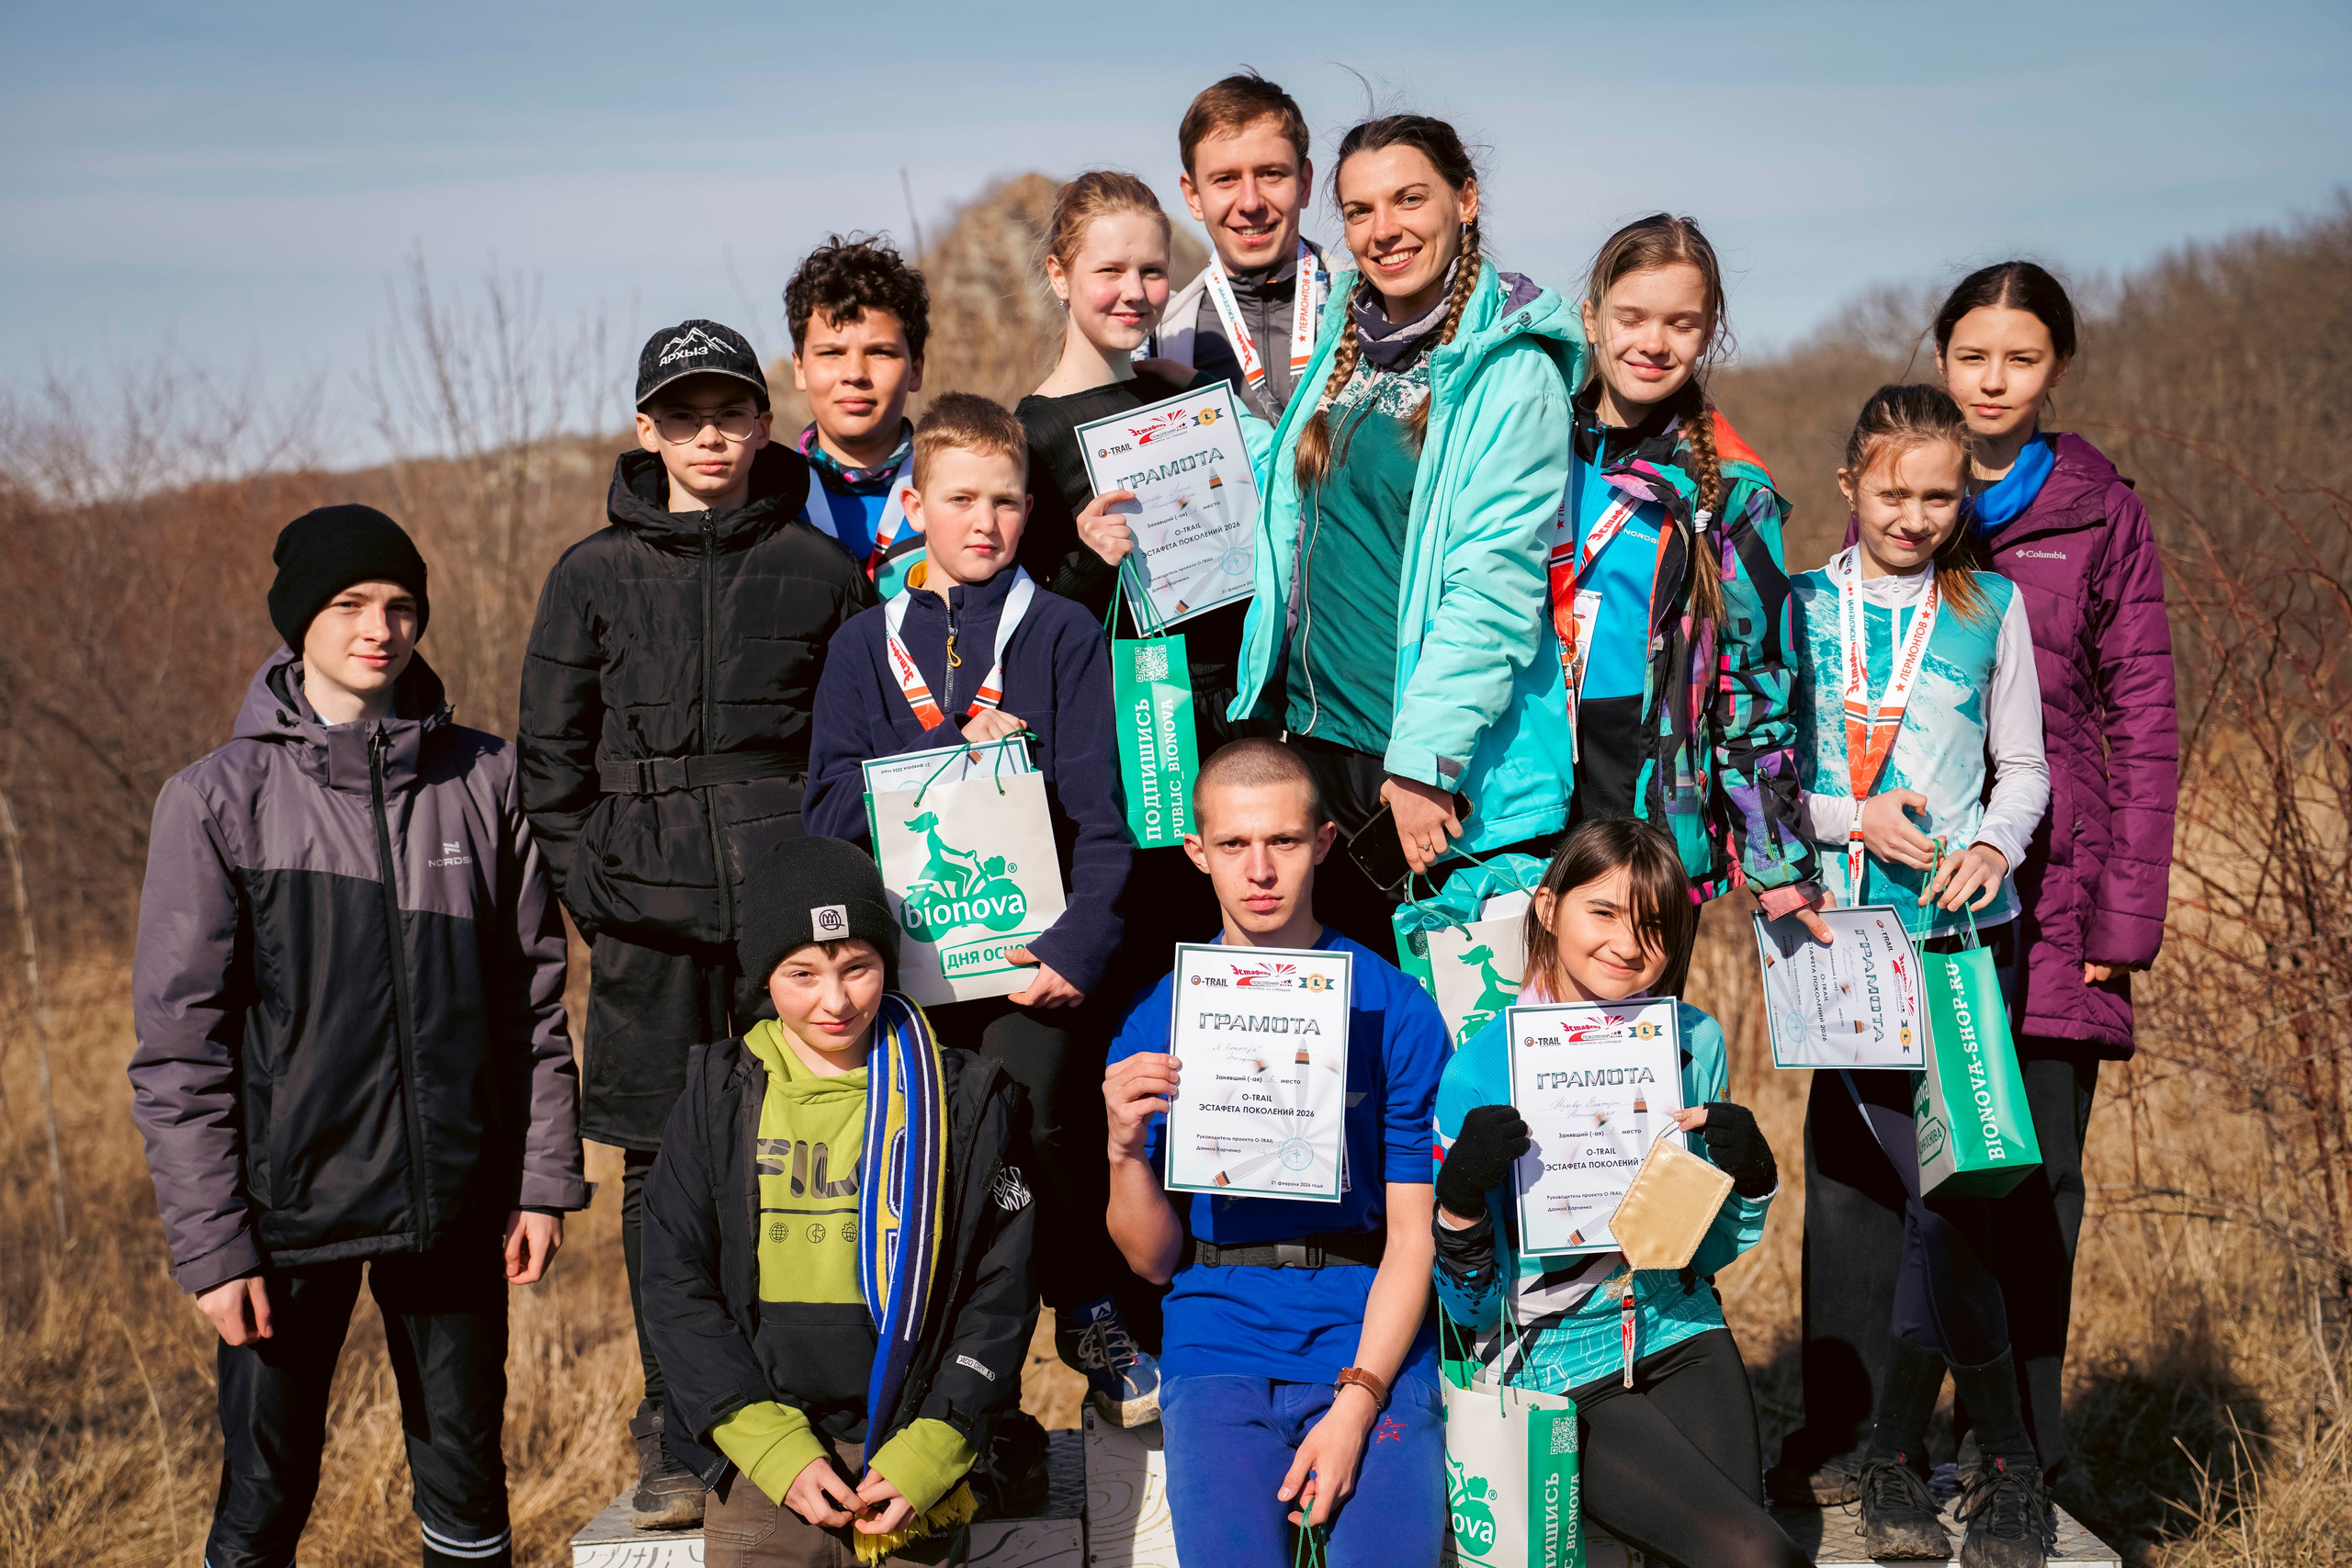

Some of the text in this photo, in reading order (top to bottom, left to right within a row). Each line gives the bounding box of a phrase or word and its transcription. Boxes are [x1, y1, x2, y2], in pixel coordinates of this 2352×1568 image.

[1299, 278, 1310, 332] ЛЕРМОНТОВ
[659, 346, 708, 367] АРХЫЗ
[1115, 446, 1225, 490] ГРАМОТА
[1203, 501, 1221, 510] место
[1141, 521, 1241, 559] ЭСТАФЕТА ПОКОЛЕНИЙ 2026
[1174, 523, 1202, 536] O-TRAIL
[1623, 528, 1658, 544] NORDS
[2026, 549, 2066, 559] Columbia
[1847, 599, 1857, 641] ПОКОЛЕНИЙ
[1899, 621, 1928, 682] ЛЕРМОНТОВ
[1134, 697, 1162, 841] ПОДПИШИСЬ
[1161, 698, 1186, 839] PUBLIC_BIONOVA
[903, 893, 1026, 929] bionova
[946, 950, 980, 970] ДНЯ
[1191, 975, 1228, 987] O-TRAIL
[1806, 934, 1816, 975] ЭСТАФЕТА
[1813, 976, 1826, 1022] ПОКОЛЕНИЙ
[1820, 974, 1829, 1002] O-TRAIL
[1854, 929, 1884, 1043] ГРАМОТА
[1199, 1011, 1321, 1035] ГРАМОТА
[1524, 1036, 1561, 1047] O-TRAIL
[1945, 962, 2006, 1160] BIONOVA-SHOP.RU
[1216, 1074, 1246, 1082] Занявший
[1536, 1066, 1656, 1089] ГРАМОТА
[1242, 1093, 1272, 1102] O-TRAIL
[1198, 1103, 1315, 1117] ЭСТАФЕТА ПОКОЛЕНИЙ 2026
[1196, 1134, 1231, 1143] Руководитель
[1586, 1147, 1616, 1156] O-TRAIL
[757, 1138, 860, 1199] FIL
[1545, 1157, 1639, 1171] ЭСТАФЕТА ПОКОЛЕНИЙ
